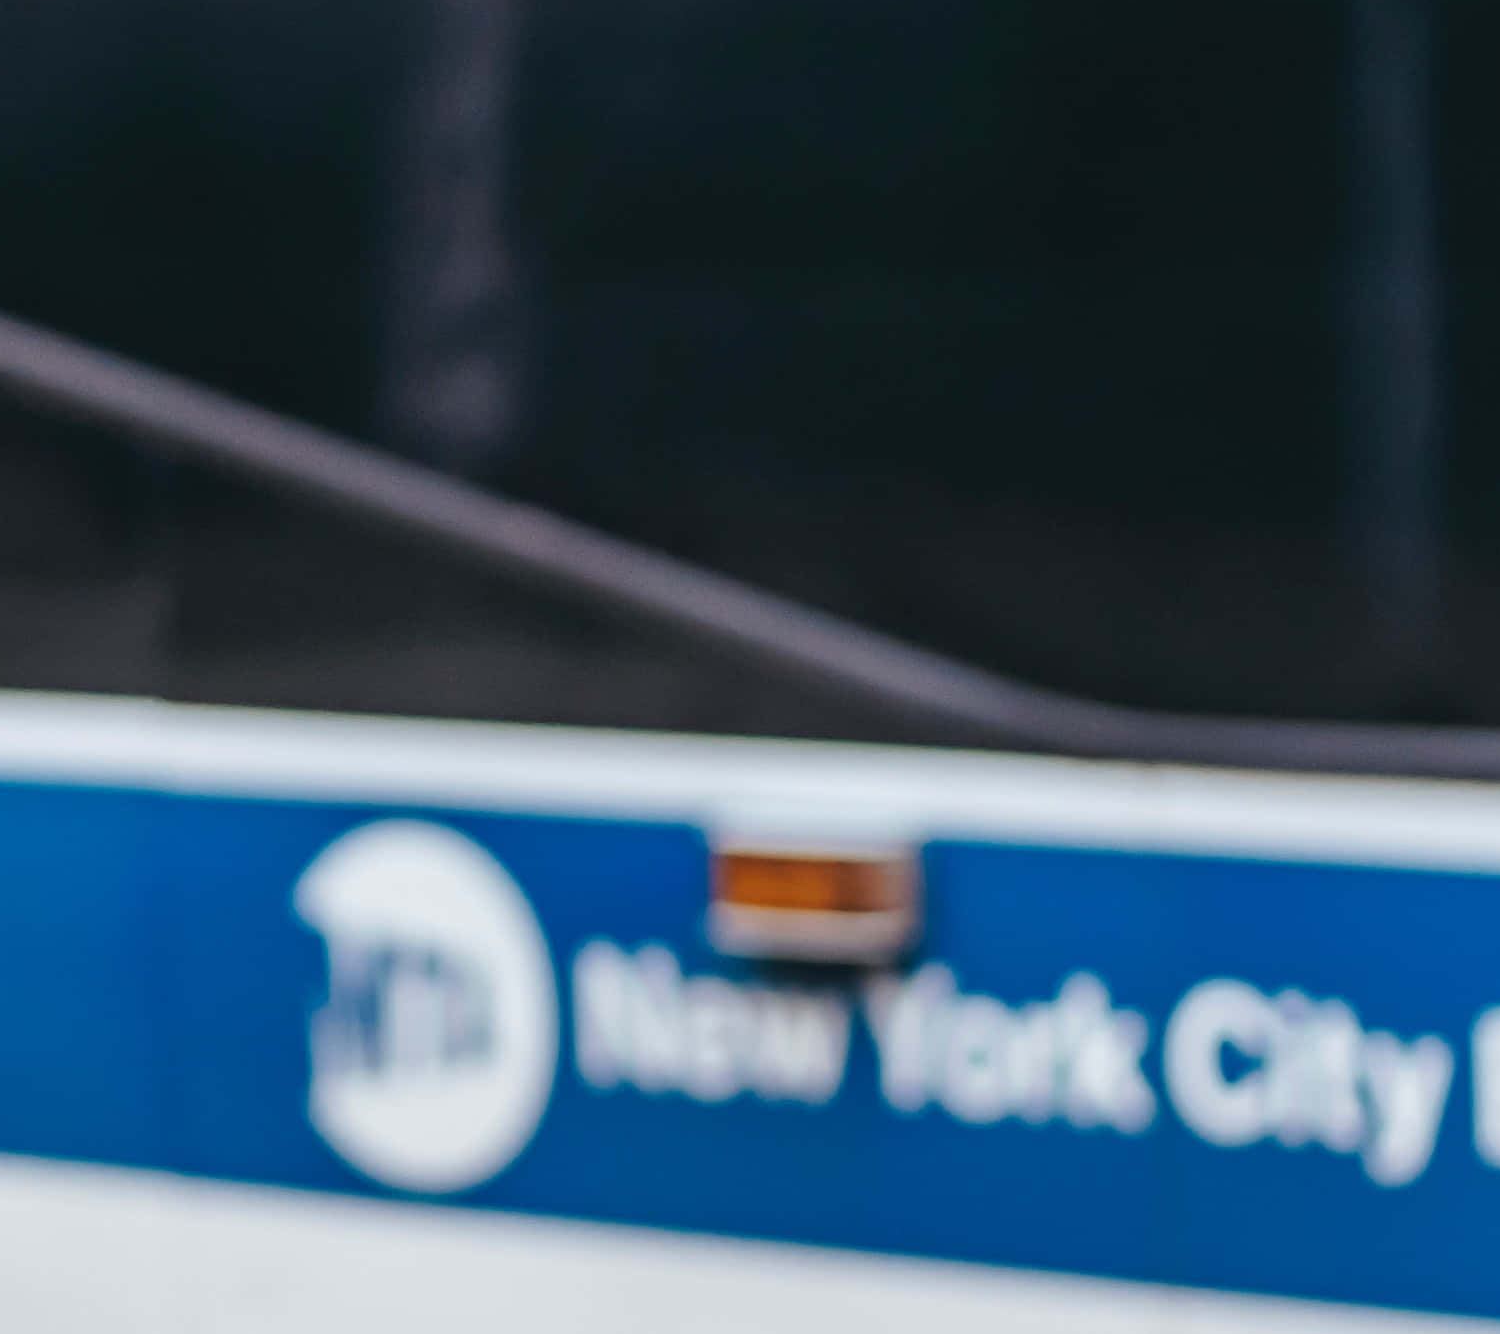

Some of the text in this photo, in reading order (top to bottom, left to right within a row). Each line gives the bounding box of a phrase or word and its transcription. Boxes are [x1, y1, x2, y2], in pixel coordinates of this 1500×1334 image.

[573, 937, 853, 1103] New
[864, 963, 1156, 1134] York
[1165, 979, 1454, 1185] City
